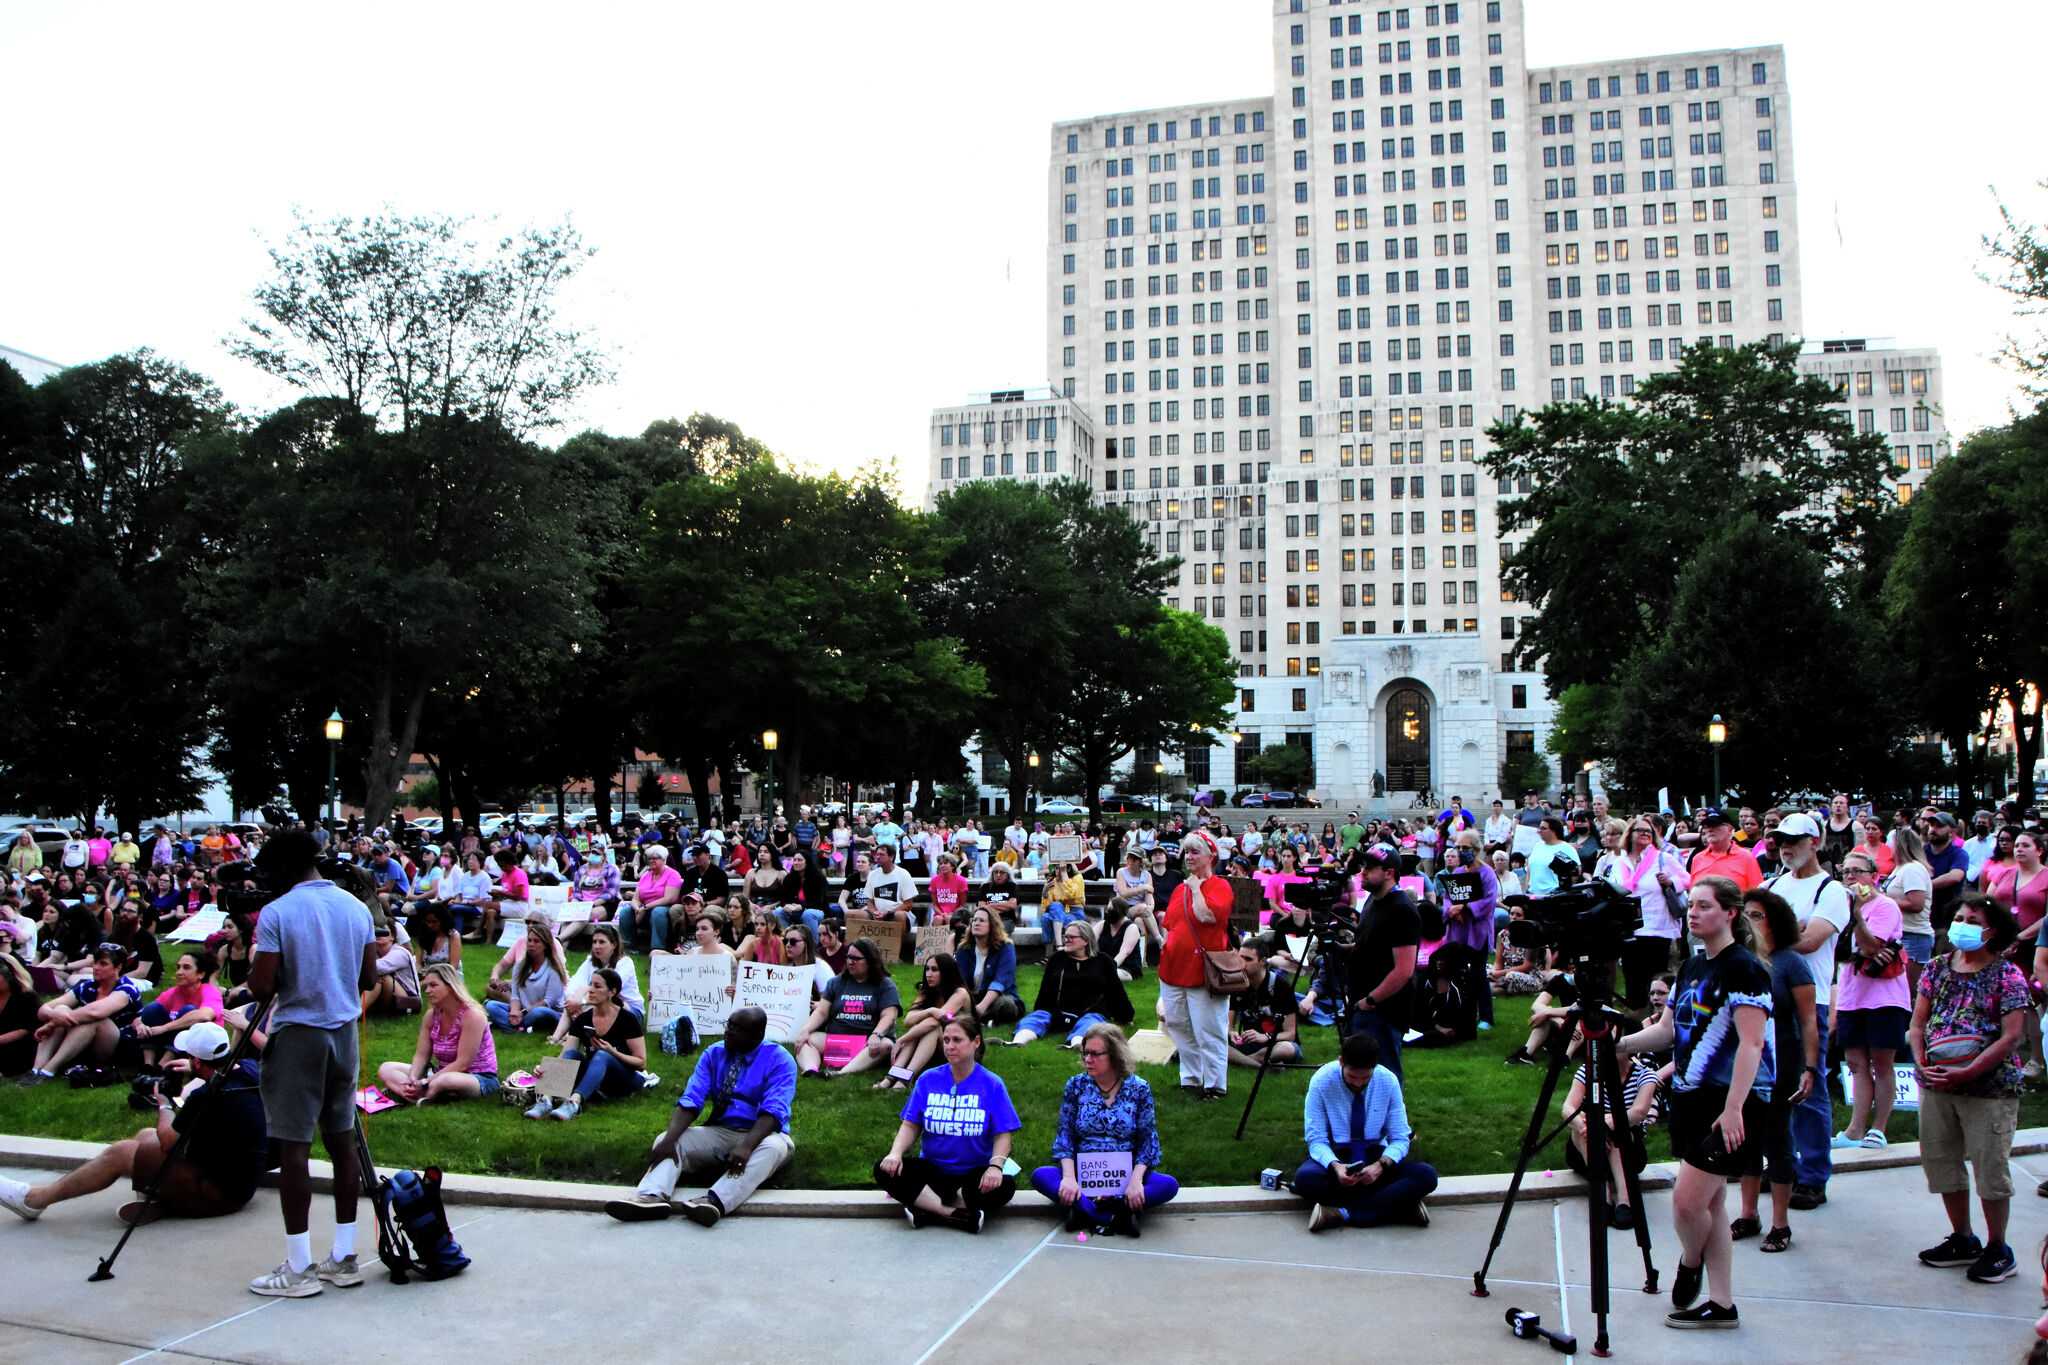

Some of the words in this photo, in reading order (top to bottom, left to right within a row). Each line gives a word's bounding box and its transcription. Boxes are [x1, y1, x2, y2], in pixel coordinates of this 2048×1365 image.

[1453, 885, 1472, 894] OUR
[1449, 893, 1470, 901] DIES
[858, 925, 895, 937] ABORT
[923, 928, 951, 939] PREGN
[699, 965, 726, 978] politics
[744, 966, 762, 980] IF
[653, 983, 676, 998] OFF
[836, 1013, 872, 1021] ABORTION
[926, 1092, 979, 1108] MARCH
[924, 1106, 954, 1121] FOR
[954, 1108, 986, 1123] OUR
[924, 1119, 963, 1137] LIVES
[1081, 1160, 1108, 1170] BANS
[1080, 1170, 1101, 1179] OFF
[1102, 1169, 1127, 1179] OUR
[1081, 1179, 1121, 1189] BODIES
